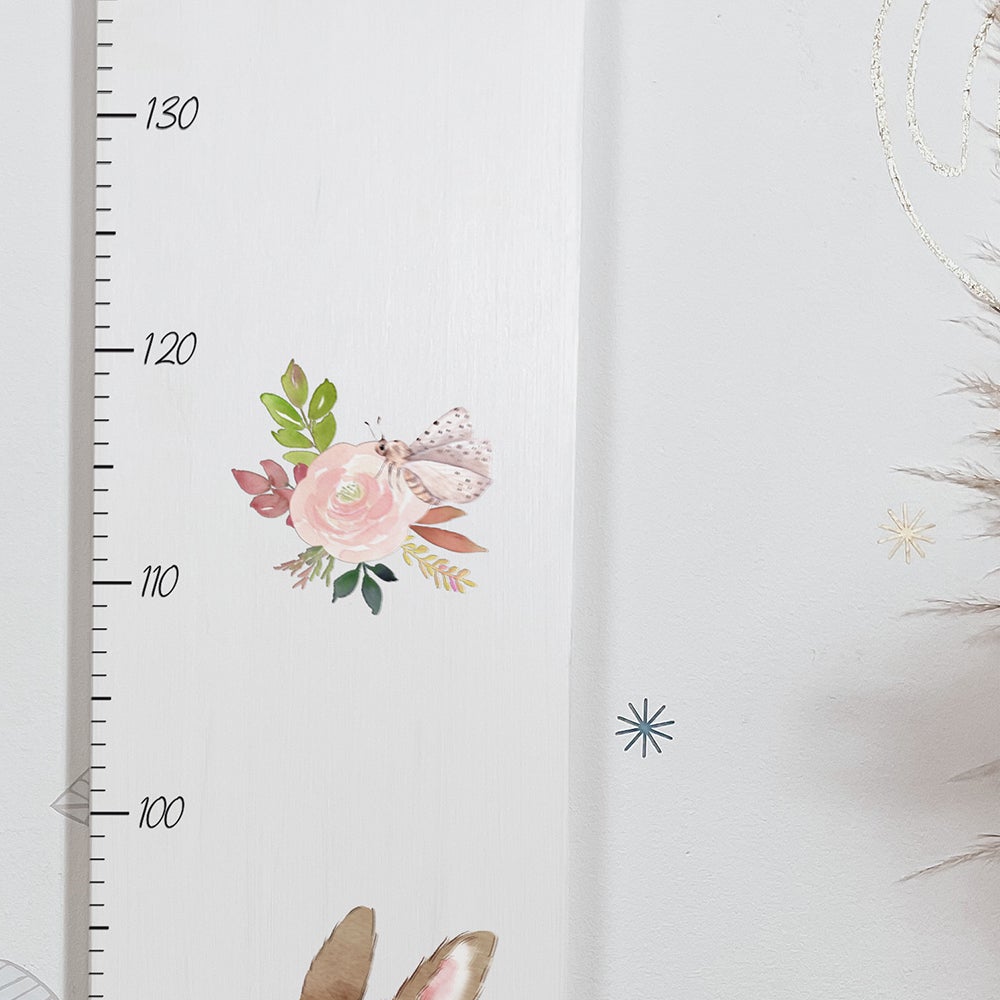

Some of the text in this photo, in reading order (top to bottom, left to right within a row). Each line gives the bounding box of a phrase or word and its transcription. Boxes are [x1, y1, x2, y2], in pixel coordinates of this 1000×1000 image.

[146, 95, 200, 131] 130
[143, 331, 198, 367] 120
[141, 563, 180, 599] 110
[138, 794, 185, 830] 100
